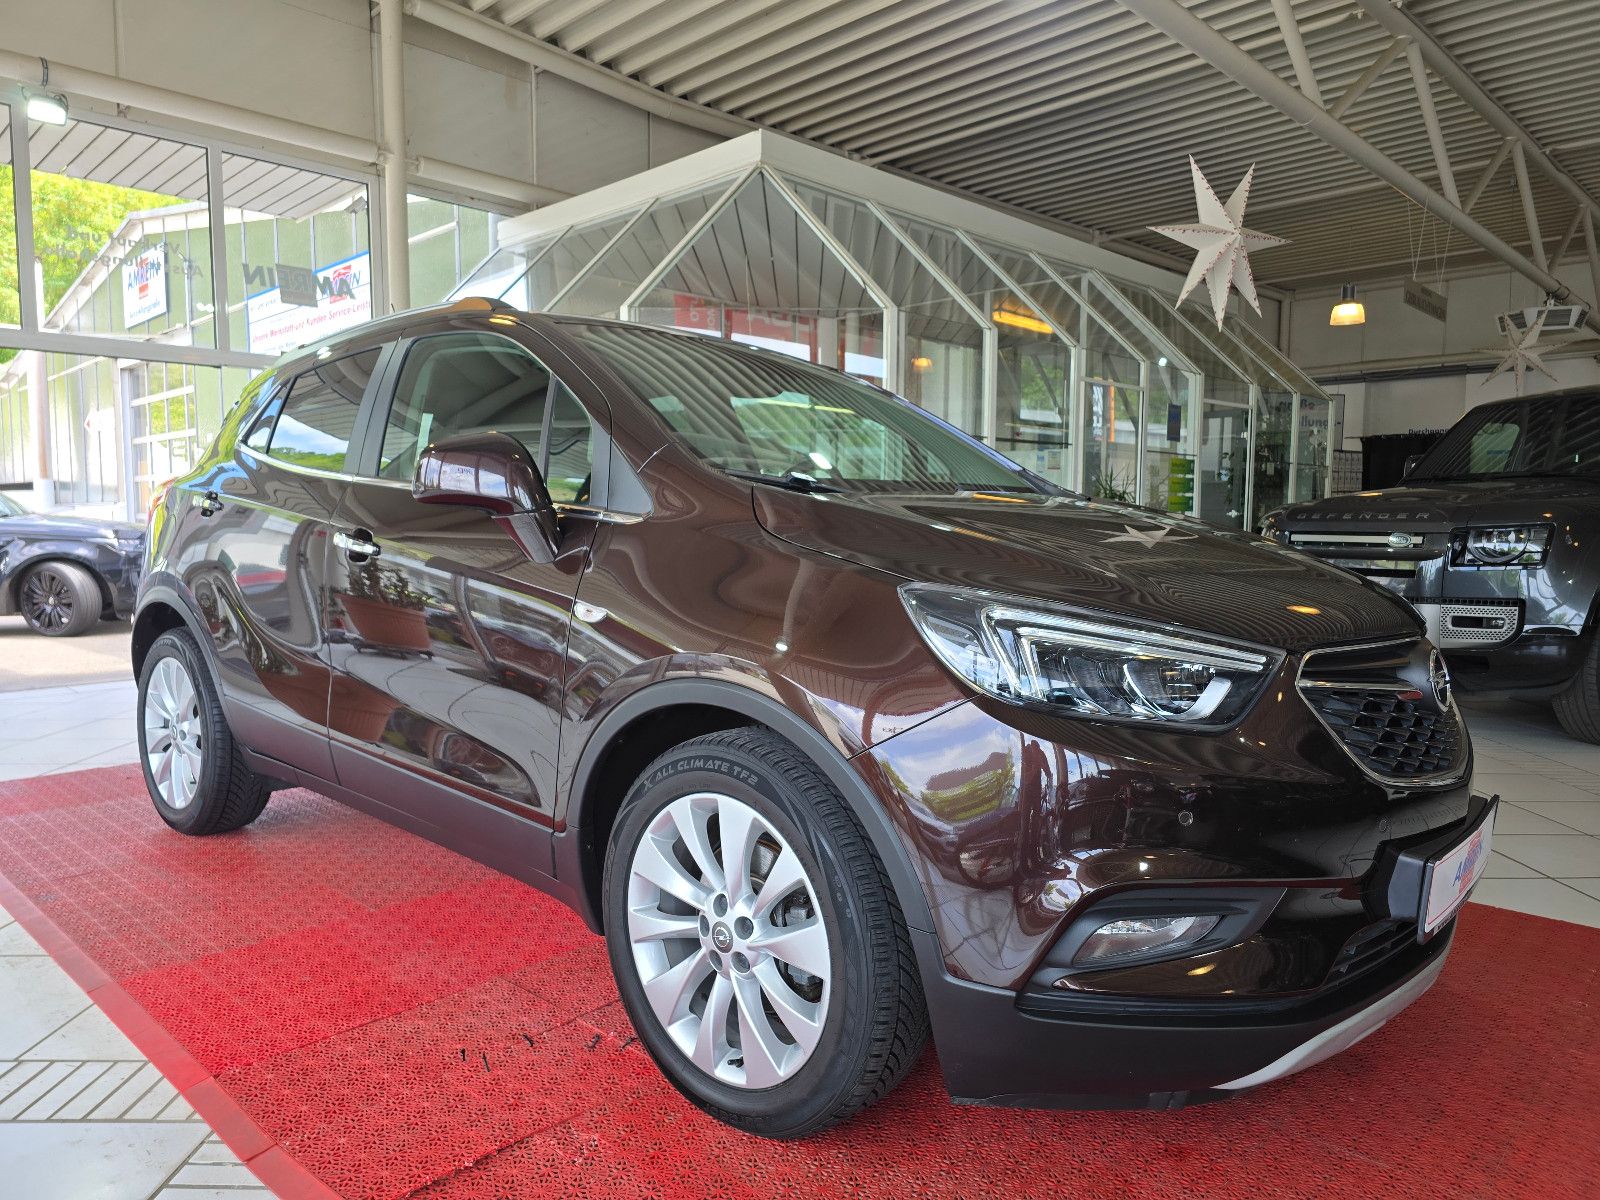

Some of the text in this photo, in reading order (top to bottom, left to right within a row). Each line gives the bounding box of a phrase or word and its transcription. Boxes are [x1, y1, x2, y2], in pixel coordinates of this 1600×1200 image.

[1297, 512, 1430, 520] DEFENDER
[655, 765, 675, 781] ALL
[677, 759, 729, 773] CLIMATE
